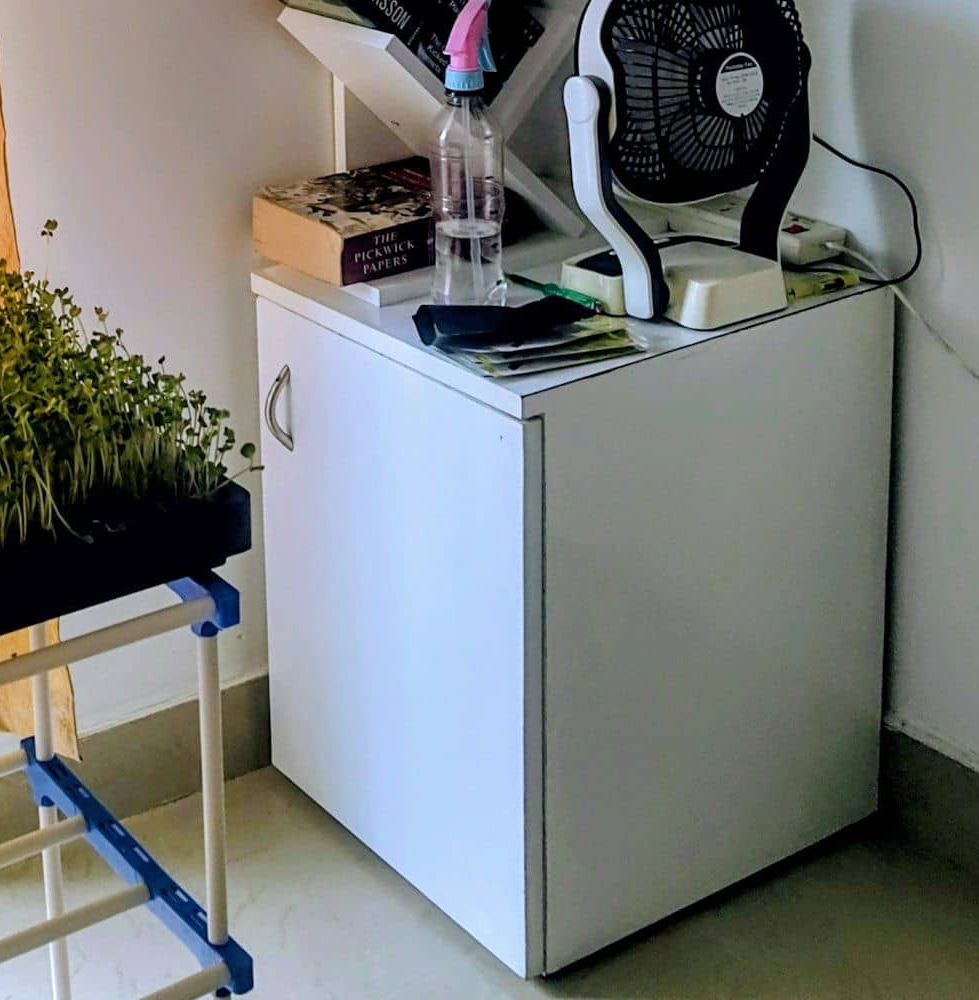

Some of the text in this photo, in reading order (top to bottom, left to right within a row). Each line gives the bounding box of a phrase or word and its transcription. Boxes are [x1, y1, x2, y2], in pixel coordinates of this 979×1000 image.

[374, 232, 397, 245] THE
[354, 240, 415, 264] PICKWICK
[363, 254, 408, 275] PAPERS
